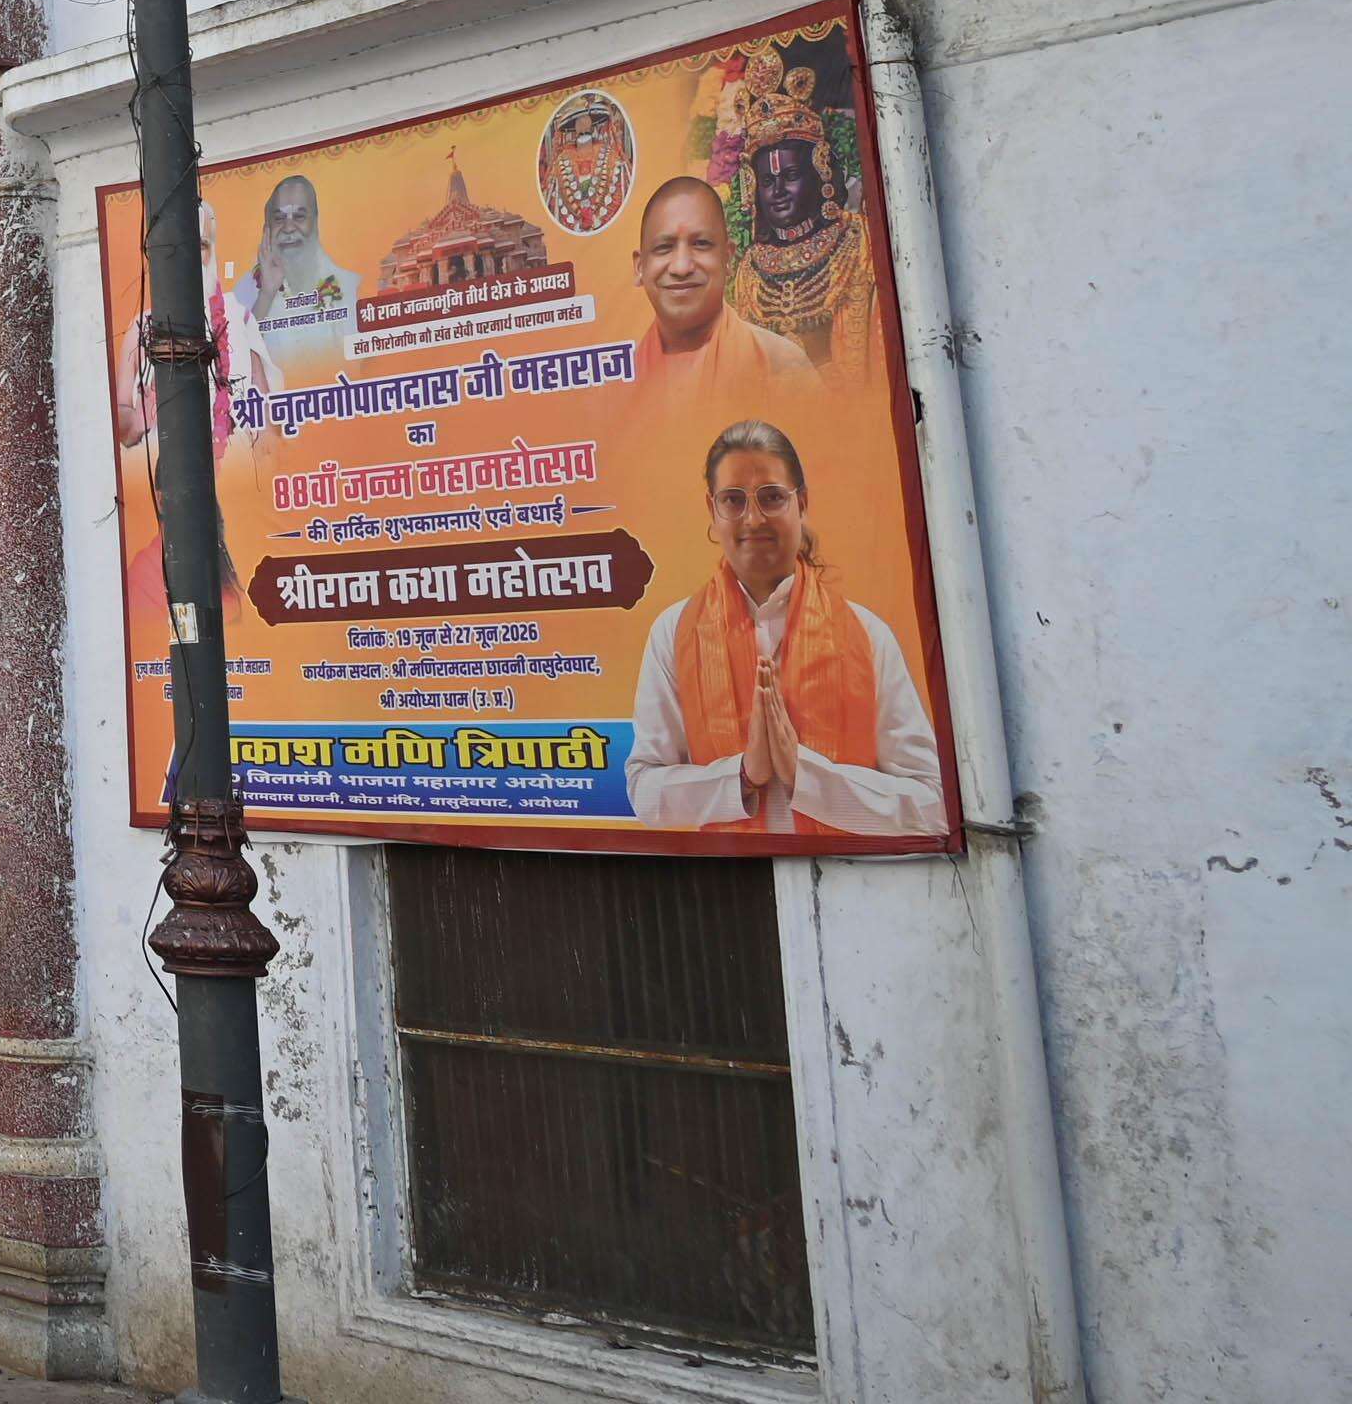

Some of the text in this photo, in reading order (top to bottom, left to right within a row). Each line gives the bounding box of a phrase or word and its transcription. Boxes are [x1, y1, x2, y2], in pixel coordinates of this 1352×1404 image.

[360, 271, 571, 323] श्री राम जन्मभूमि तीर्थ क्षेत्र के अध्यक्ष
[354, 339, 370, 355] संत
[371, 331, 417, 352] शिरोमणि
[434, 323, 452, 341] संत
[453, 319, 474, 340] सेवी
[476, 314, 512, 335] परमार्थ
[514, 310, 555, 330] पारायण
[557, 304, 583, 323] महंत
[233, 343, 634, 435] श्री नृत्यगोपालदास जी महाराज
[407, 423, 435, 446] का
[341, 463, 414, 502] जन्म
[416, 439, 597, 494] महामहोत्सव
[308, 497, 565, 542] की हार्दिक शुभकामनाएं एवं बधाई
[276, 546, 612, 611] श्रीराम कथा महोत्सव
[348, 627, 387, 648] दिनांक
[396, 629, 411, 646] 19
[414, 628, 437, 651] जून
[439, 623, 455, 644] से
[456, 626, 471, 643] 27
[475, 625, 498, 648] जून
[502, 623, 538, 643] 2026
[302, 660, 347, 680] कार्यक्रम
[392, 657, 407, 678] श्री
[408, 656, 484, 678] मणिरामदास
[486, 655, 526, 676] छावनी
[380, 689, 395, 709] श्री
[398, 689, 442, 709] अयोध्या
[444, 691, 469, 708] धाम
[230, 725, 609, 770] काश मणि त्रिपाठी
[247, 769, 331, 786] जिलामंत्री
[339, 774, 406, 789] भाजपा
[412, 776, 496, 790] महानगर
[504, 773, 593, 790] अयोध्या
[349, 793, 382, 806] कोठा
[519, 795, 579, 809] अयोध्या
